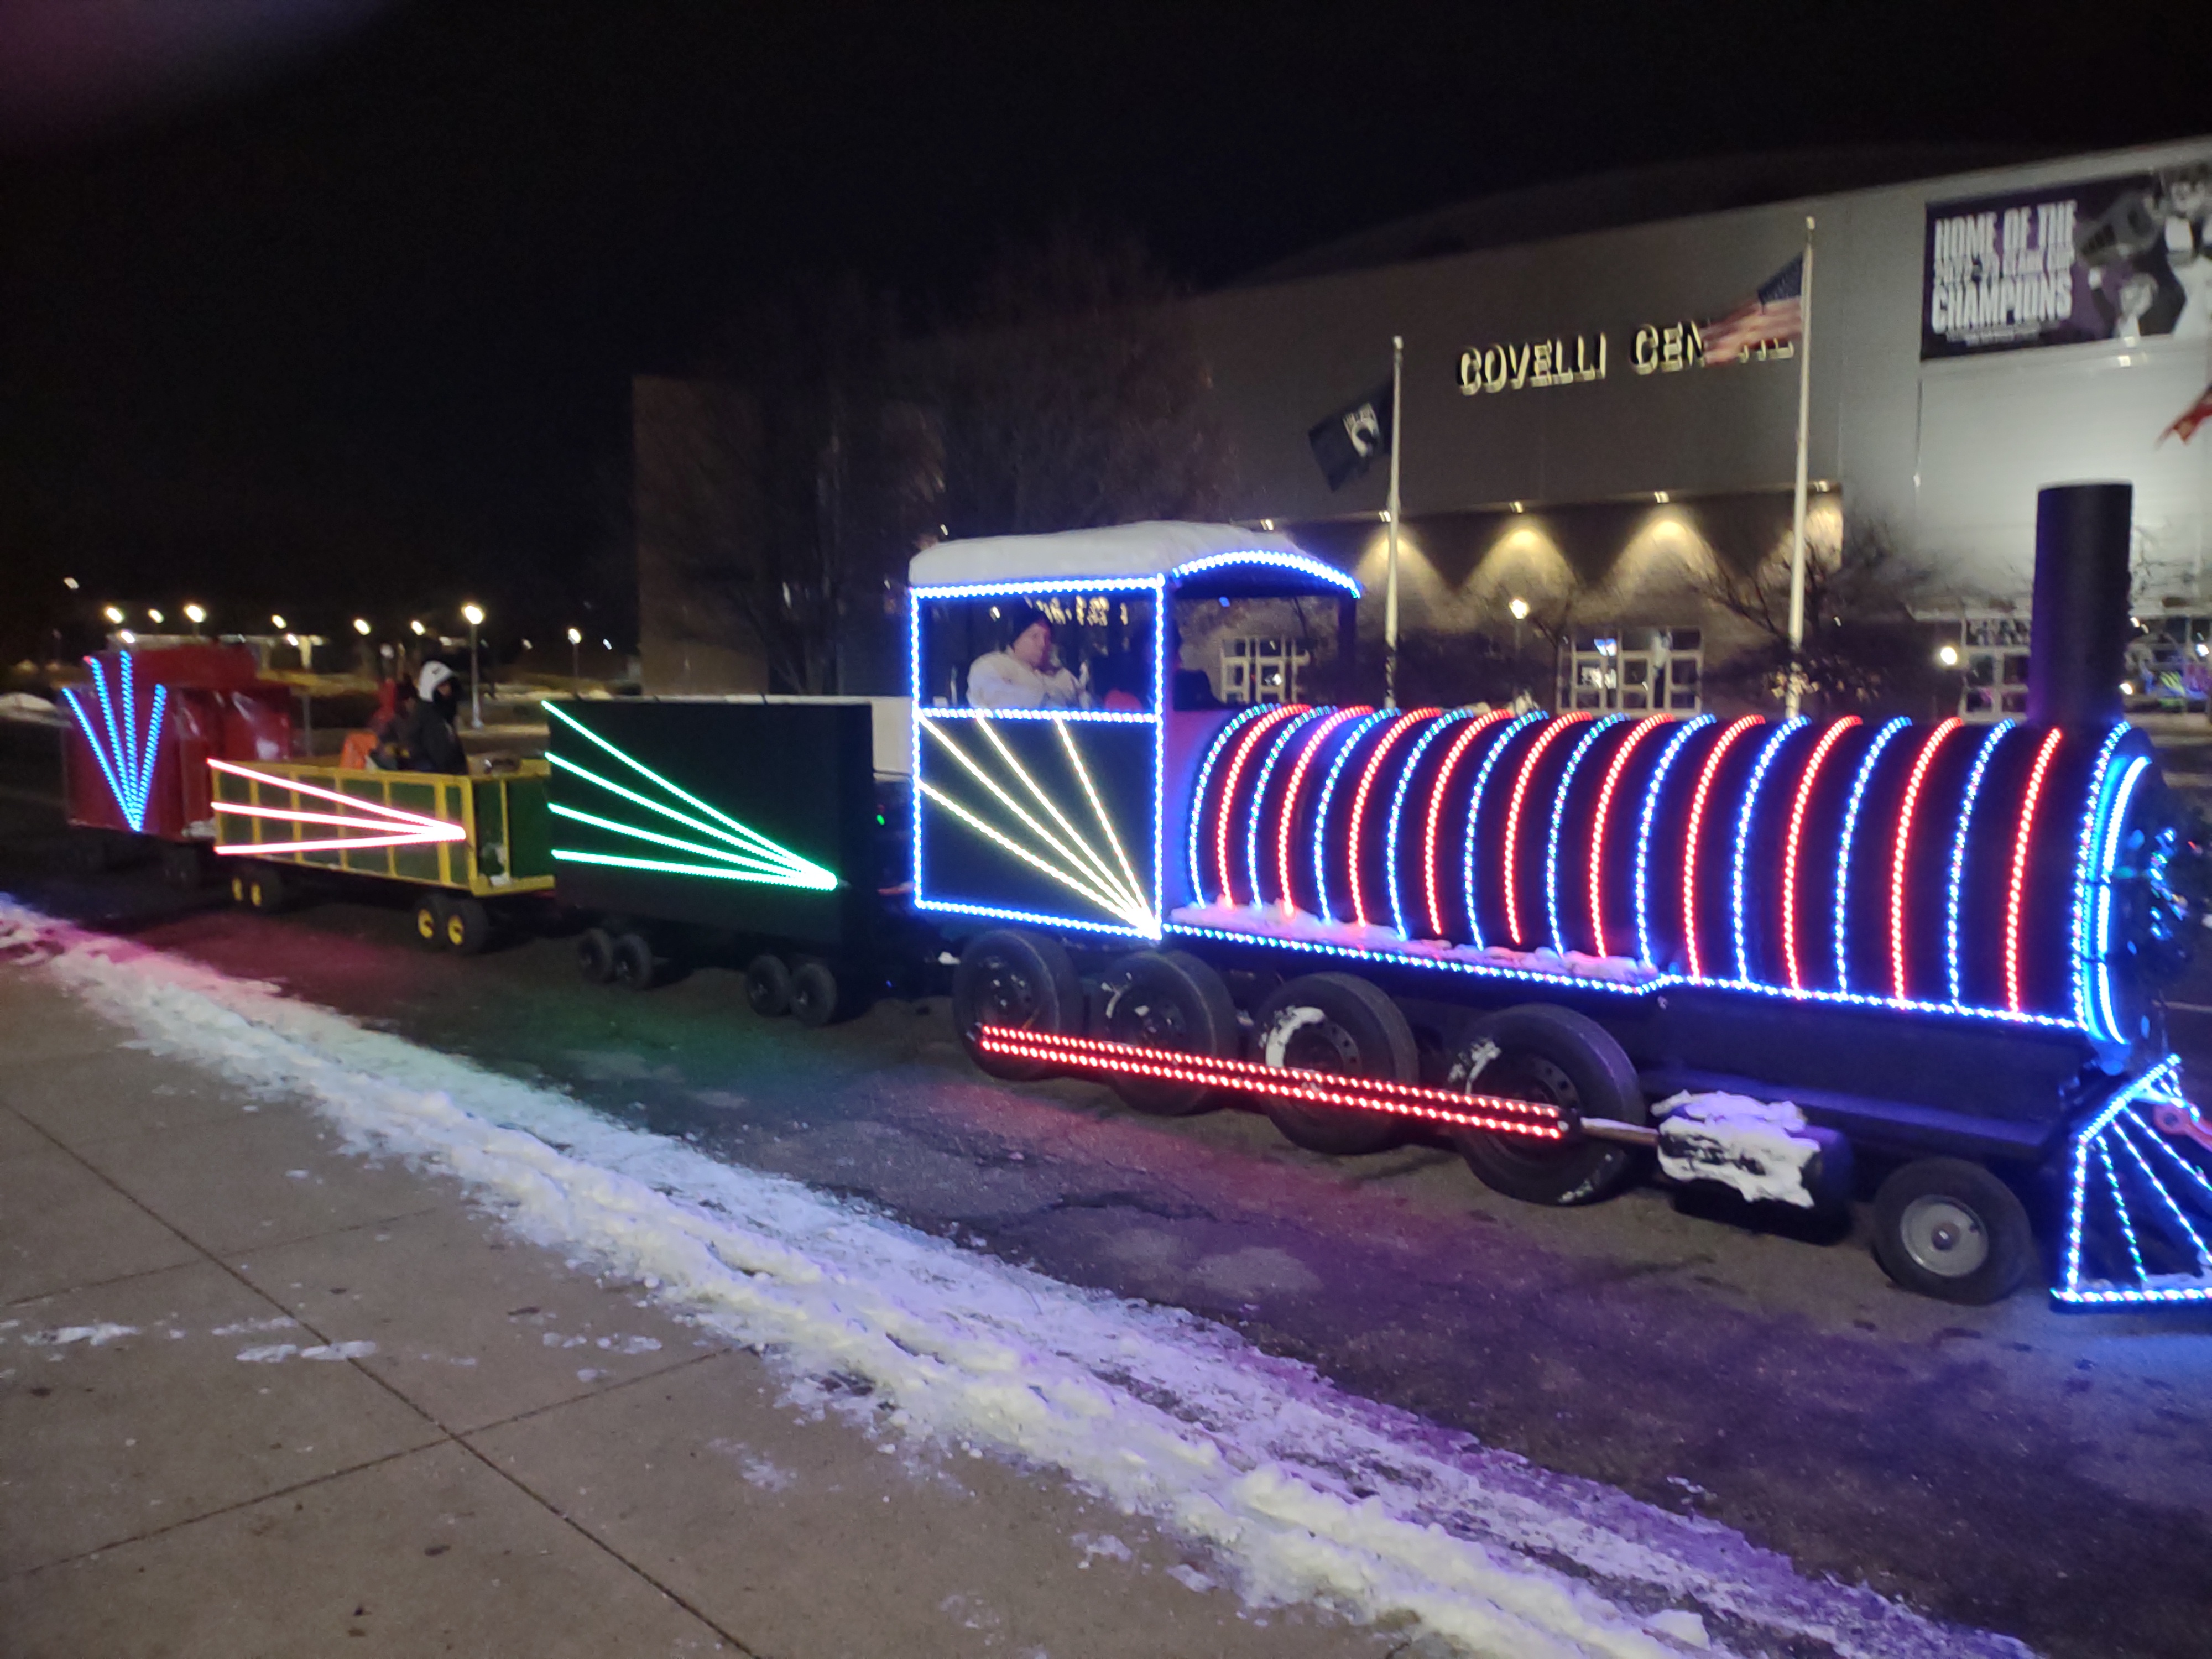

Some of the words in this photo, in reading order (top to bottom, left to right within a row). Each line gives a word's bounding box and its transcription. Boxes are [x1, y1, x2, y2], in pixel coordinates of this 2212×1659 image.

[1934, 212, 1996, 259] HOME
[2004, 207, 2031, 251] OF
[1932, 271, 2072, 333] CHAMPIONS
[1459, 332, 1606, 395] COVELLI
[1629, 321, 1794, 375] CEN
